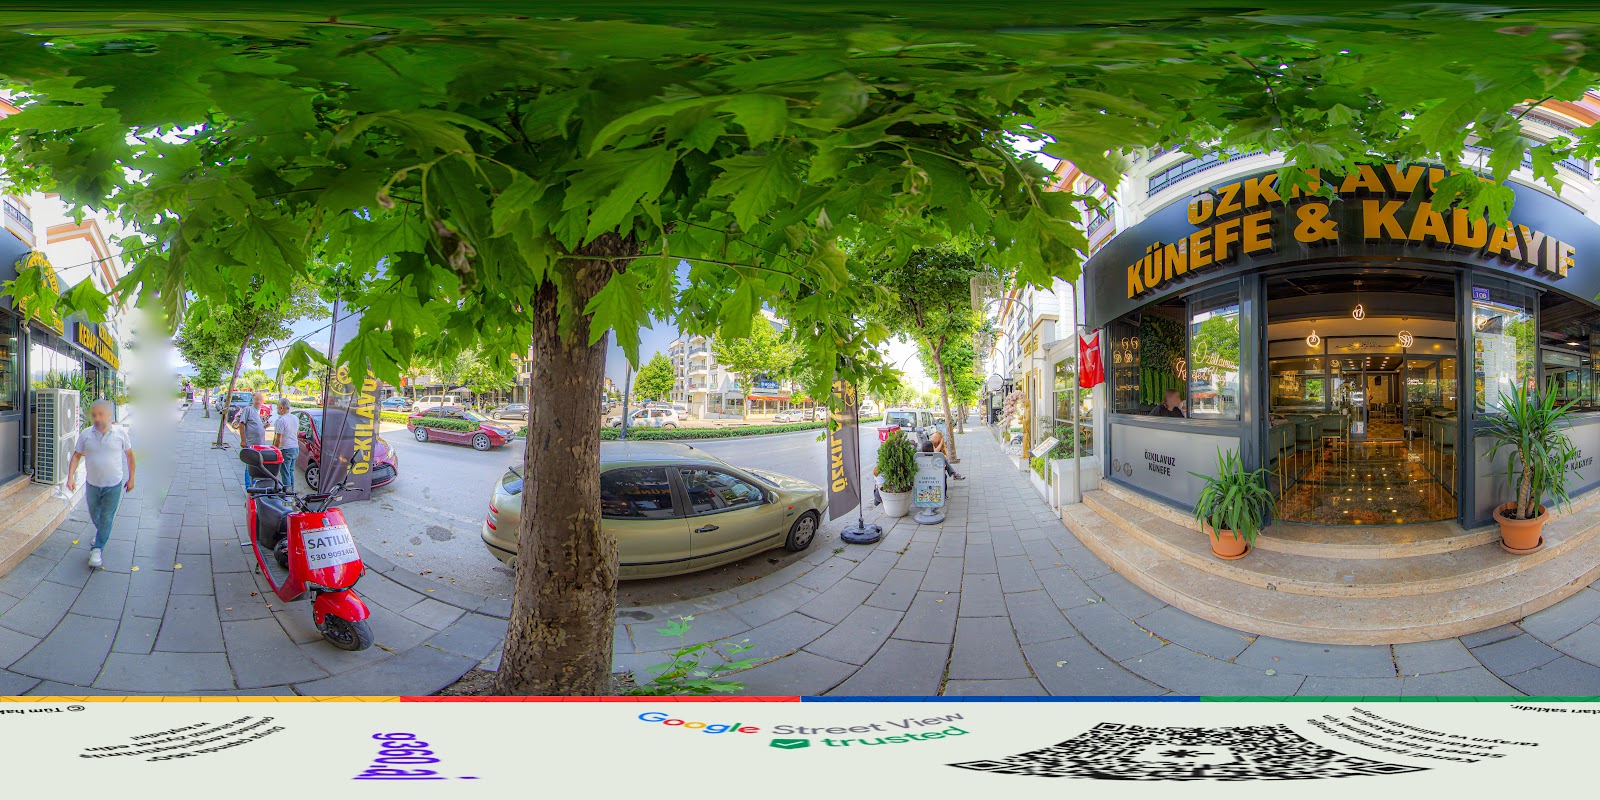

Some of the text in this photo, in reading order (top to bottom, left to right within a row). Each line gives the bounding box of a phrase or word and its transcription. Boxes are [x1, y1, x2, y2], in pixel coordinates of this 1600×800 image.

[1127, 200, 1576, 299] KÜNEFE & KADAYIF
[1144, 449, 1176, 466] ÖZKILAVUZ
[1148, 462, 1170, 476] KÜNEFE
[308, 534, 352, 549] SATILIK
